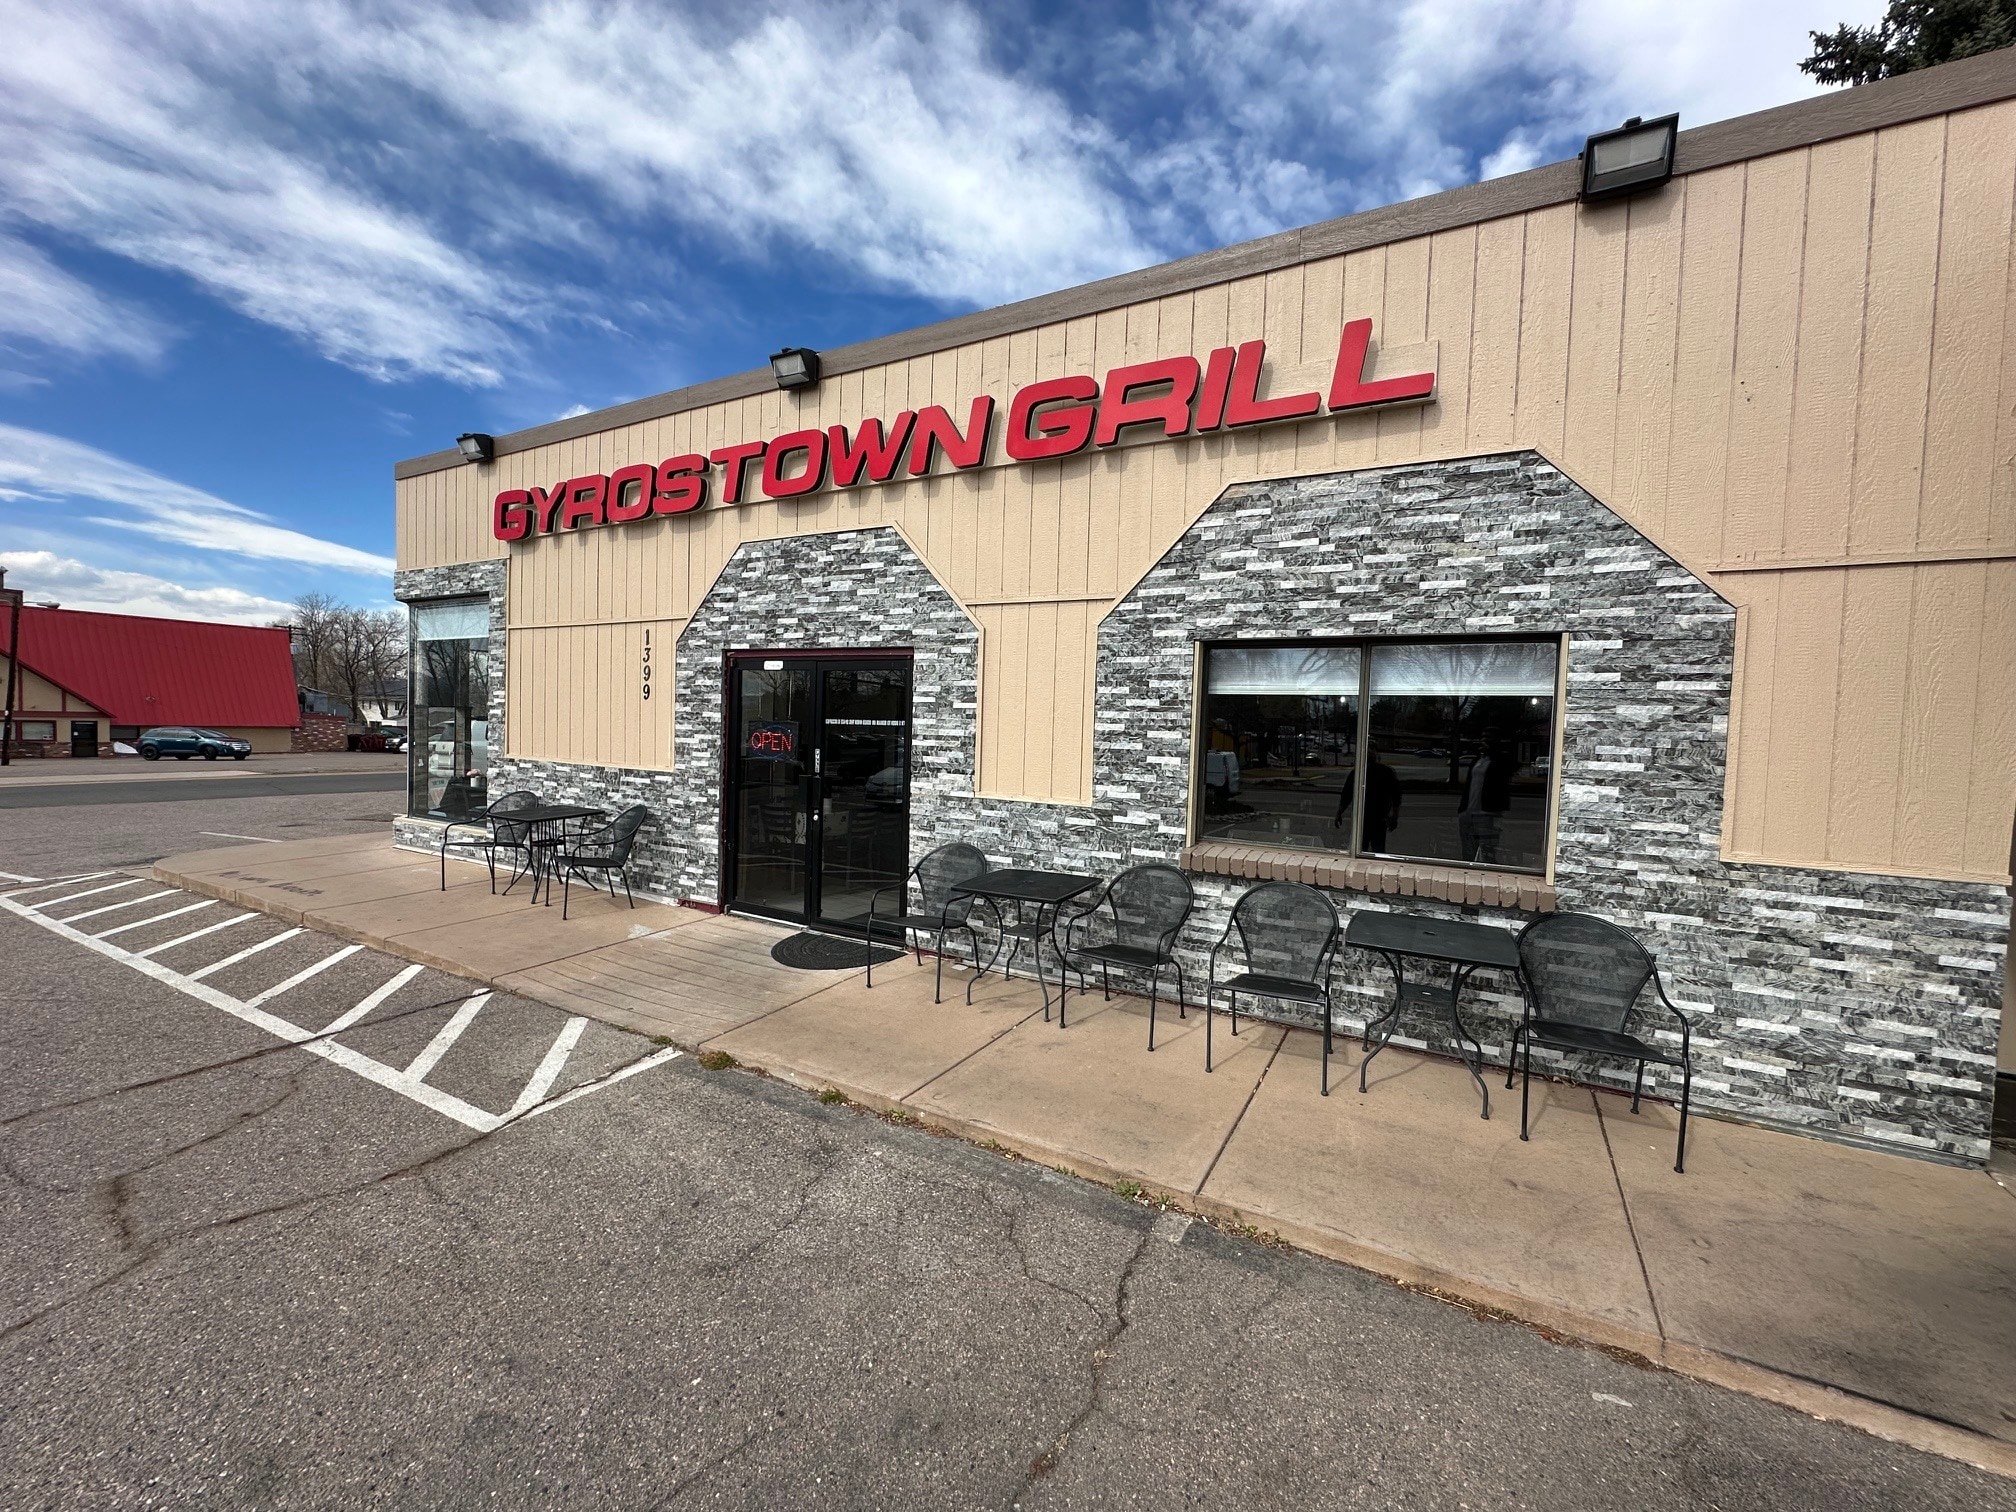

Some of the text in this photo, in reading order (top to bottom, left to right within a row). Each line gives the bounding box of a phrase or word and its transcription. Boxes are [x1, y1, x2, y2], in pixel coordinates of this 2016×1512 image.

[1006, 318, 1435, 461] GRILL
[643, 629, 651, 700] 1399
[751, 732, 792, 751] OPEN
